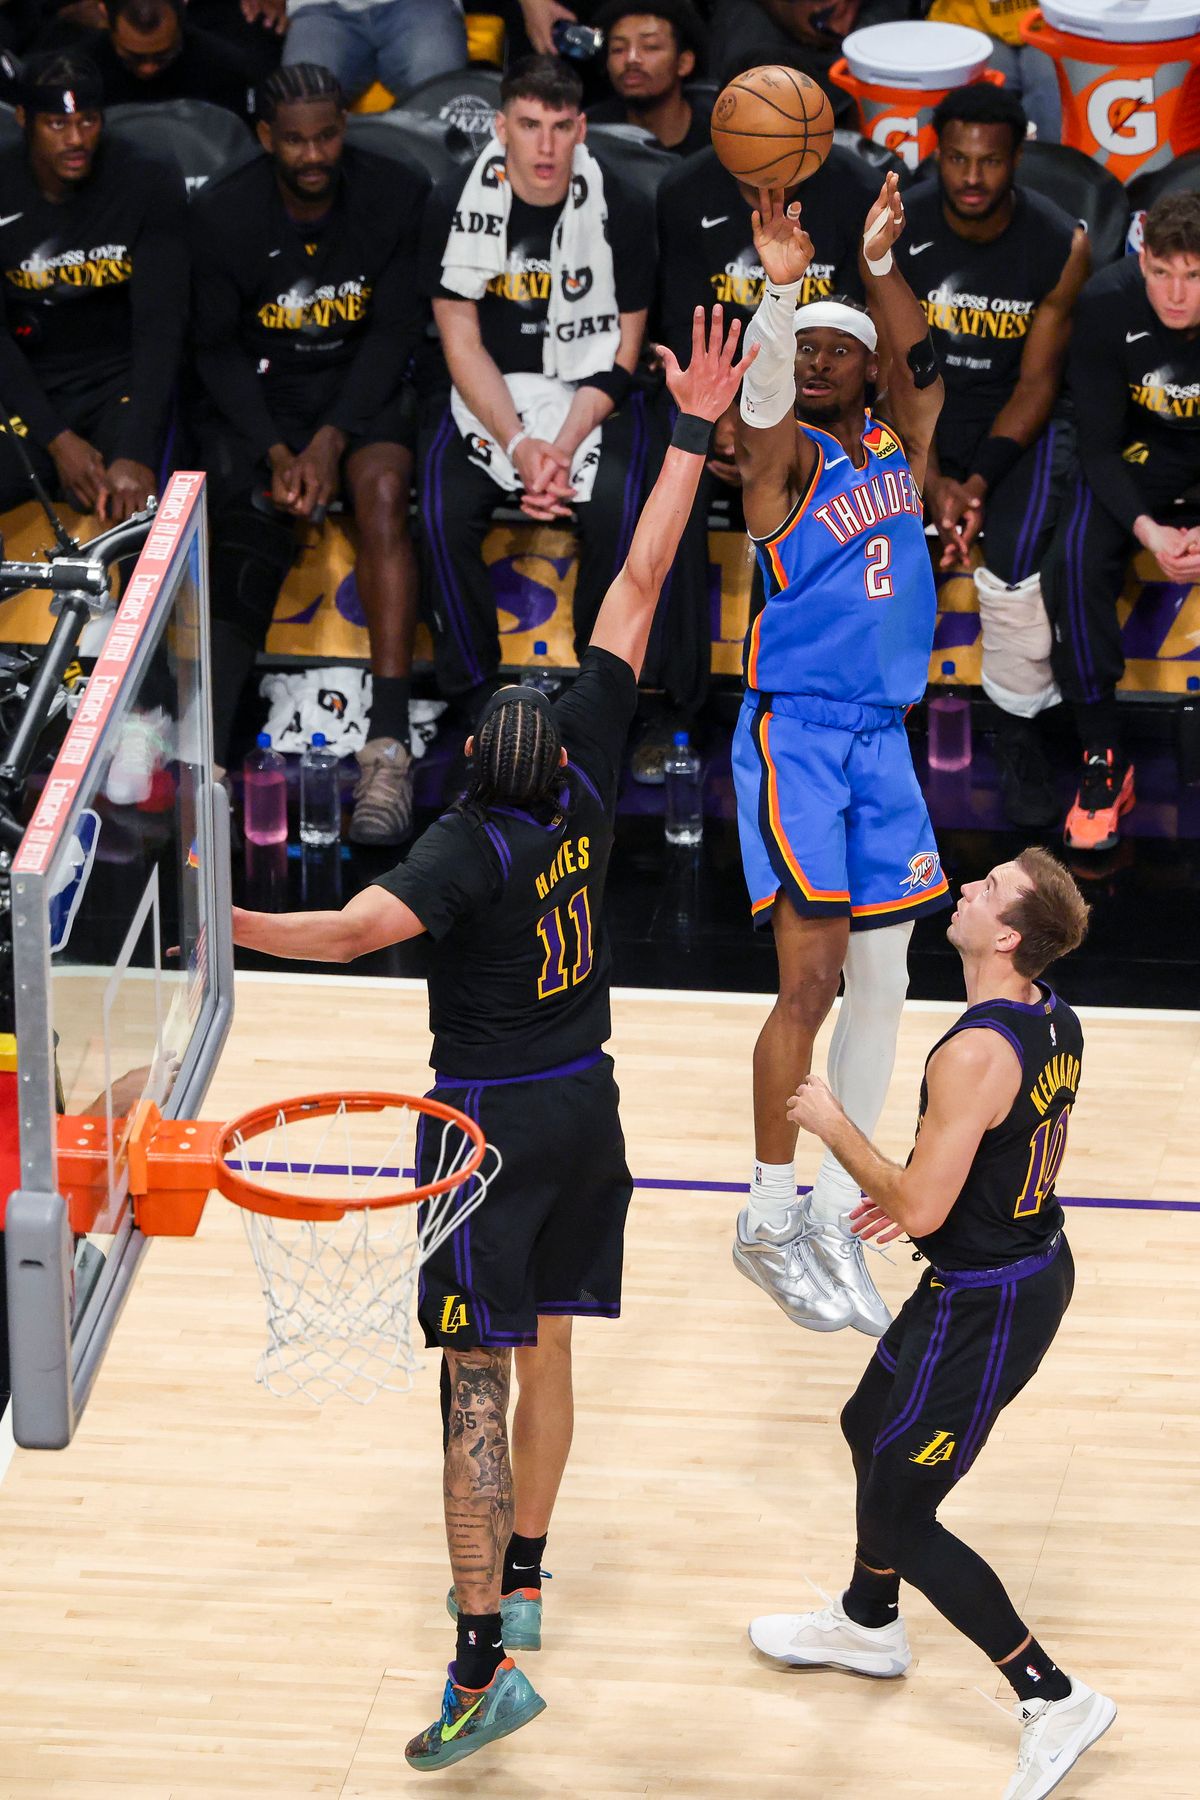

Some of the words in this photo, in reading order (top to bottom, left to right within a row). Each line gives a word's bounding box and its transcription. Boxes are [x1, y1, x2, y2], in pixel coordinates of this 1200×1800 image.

[1087, 77, 1158, 156] G
[805, 262, 836, 279] ver
[556, 314, 620, 343] GAT
[991, 298, 1035, 316] over
[161, 474, 199, 520] Emirates
[864, 534, 895, 601] 2
[119, 574, 159, 620] Emirates
[534, 835, 591, 901] HAYES
[536, 885, 594, 1001] 11
[1030, 1052, 1081, 1116] KENNARD
[1013, 1103, 1071, 1219] 10
[437, 1294, 471, 1334] LA
[908, 1430, 956, 1466] LA
